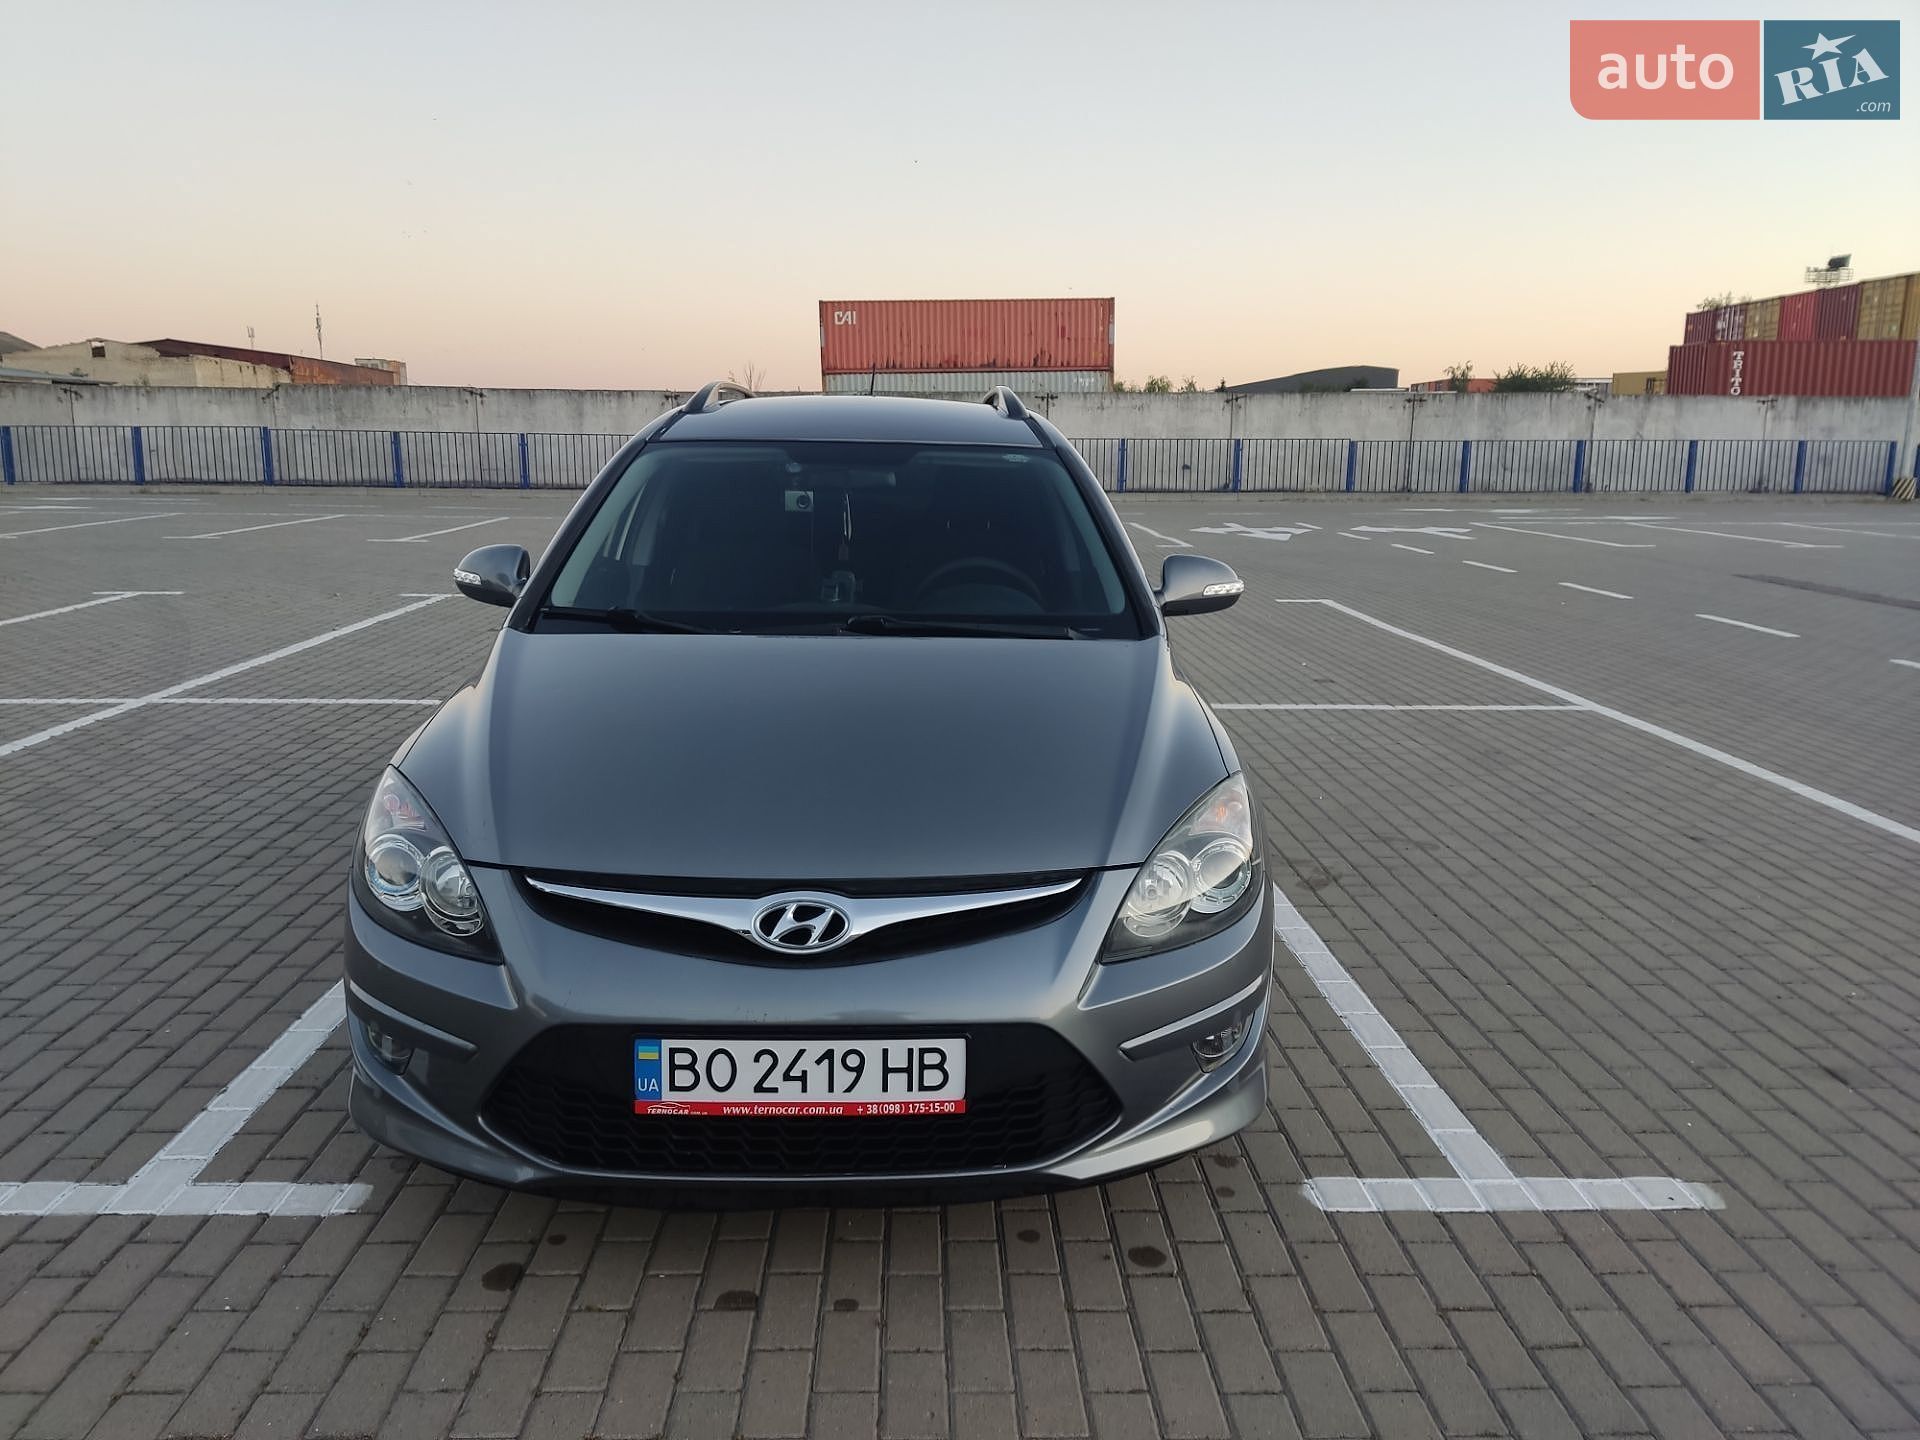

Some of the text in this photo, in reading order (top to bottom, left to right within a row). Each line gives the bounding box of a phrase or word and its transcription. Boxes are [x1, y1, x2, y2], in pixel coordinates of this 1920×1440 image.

[834, 310, 857, 325] CAI
[668, 1047, 950, 1093] BO 2419 HB
[637, 1077, 660, 1092] UA
[722, 1104, 844, 1115] www.ternocar.com.ua
[908, 1102, 956, 1114] 175-15-00
